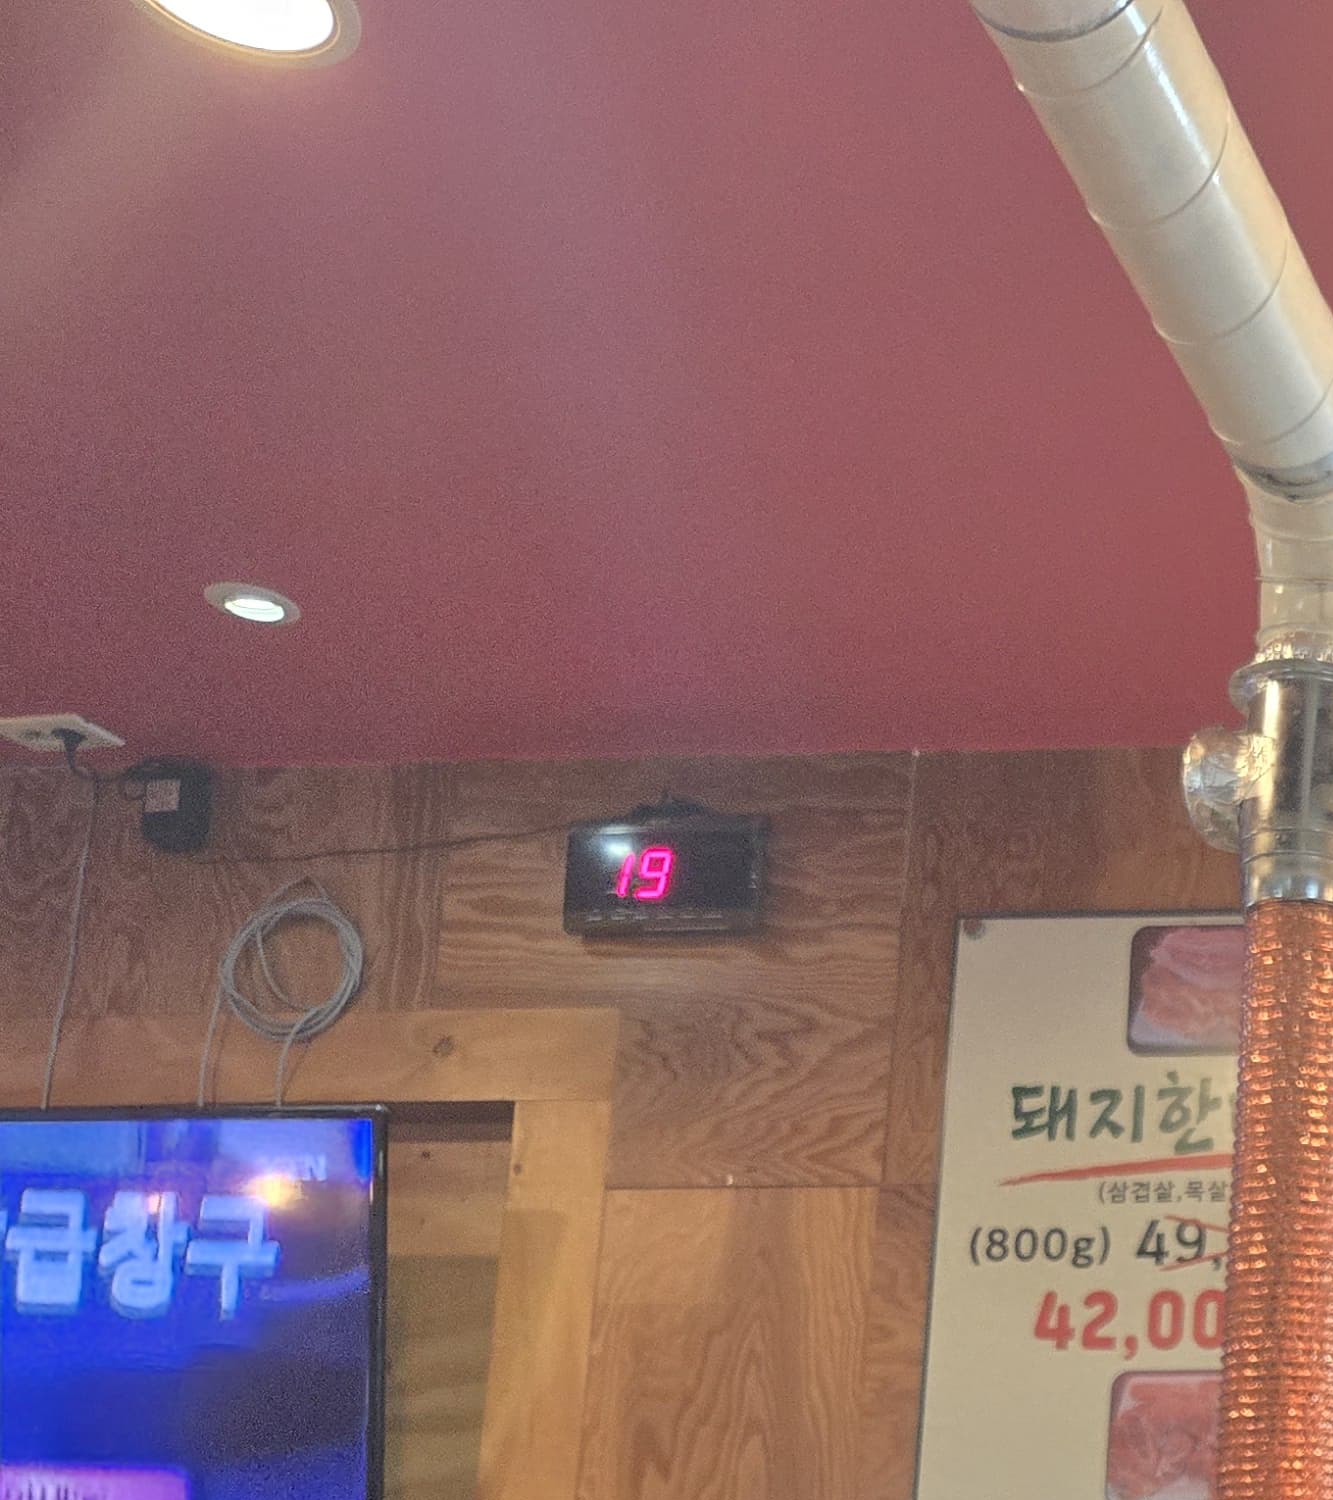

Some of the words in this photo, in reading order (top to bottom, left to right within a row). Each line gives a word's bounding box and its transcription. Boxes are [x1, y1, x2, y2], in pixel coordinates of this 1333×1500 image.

[615, 846, 674, 902] 19
[1010, 1071, 1235, 1154] 돼지한
[1099, 1180, 1233, 1205] (삼겹살,목살
[0, 1187, 281, 1320] 급창구
[970, 1225, 1111, 1268] (800g)
[1033, 1288, 1225, 1360] 42,00
